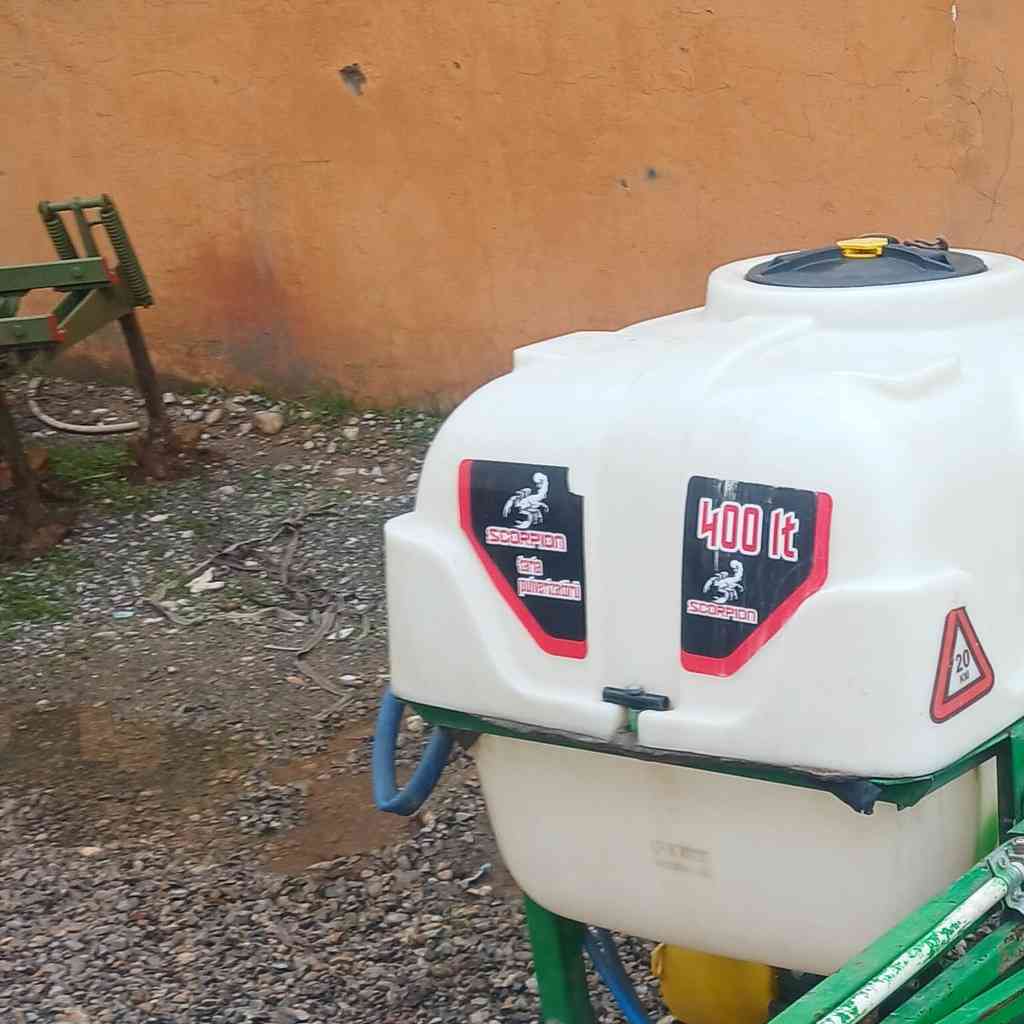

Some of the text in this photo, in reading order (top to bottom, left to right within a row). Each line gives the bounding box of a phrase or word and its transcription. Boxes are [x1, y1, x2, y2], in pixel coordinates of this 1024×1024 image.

[697, 498, 763, 555] 400
[486, 527, 568, 552] SCORPION
[687, 599, 758, 624] SCORPION
[956, 649, 970, 673] 20
